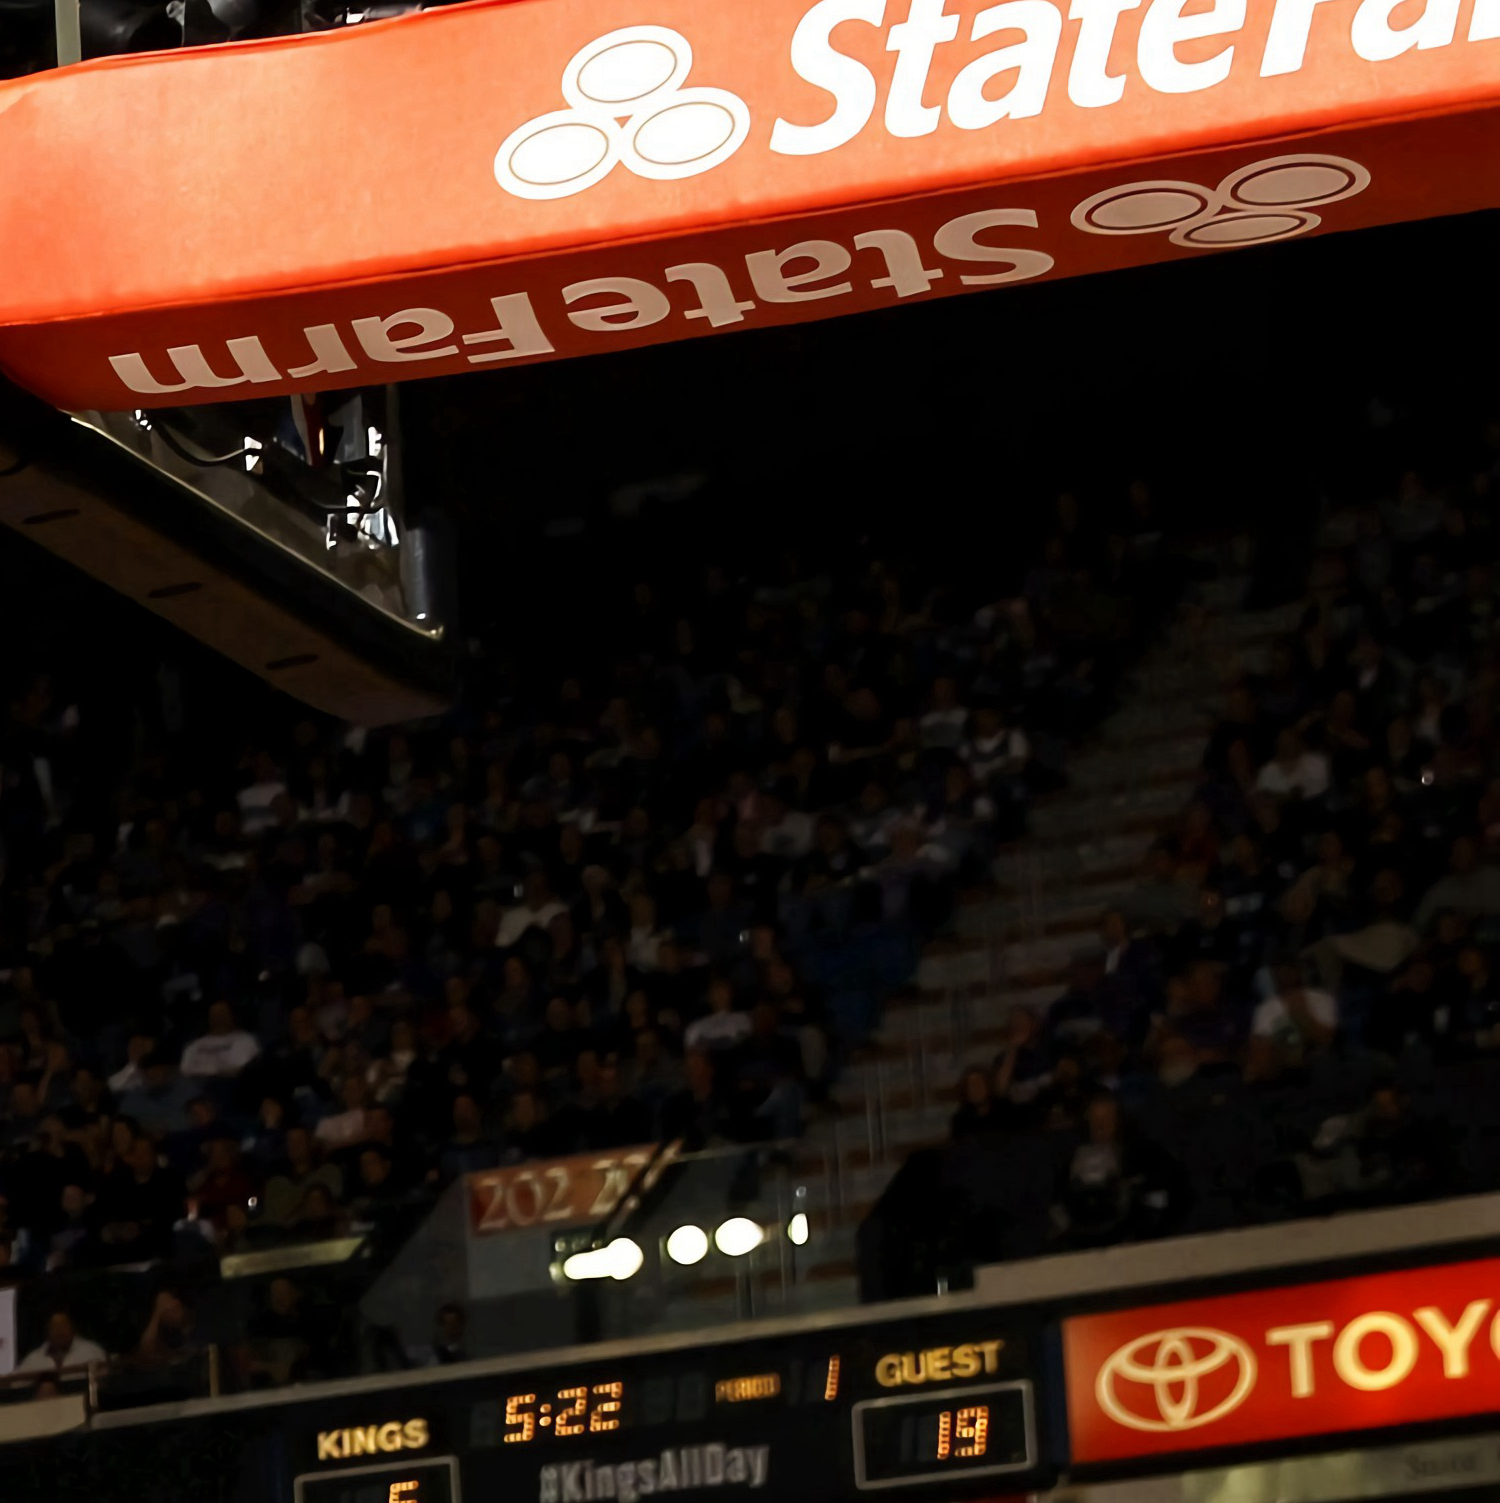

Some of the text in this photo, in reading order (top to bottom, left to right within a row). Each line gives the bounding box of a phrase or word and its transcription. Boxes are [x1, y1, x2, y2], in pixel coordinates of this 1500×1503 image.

[769, 0, 1243, 155] State
[108, 207, 1055, 395] State Farm
[476, 1164, 574, 1232] 202
[875, 1339, 1005, 1388] GUEST
[1266, 1299, 1500, 1399] TOY
[316, 1418, 430, 1461] KINGS
[503, 1381, 623, 1444] 5:22
[937, 1406, 990, 1461] 19
